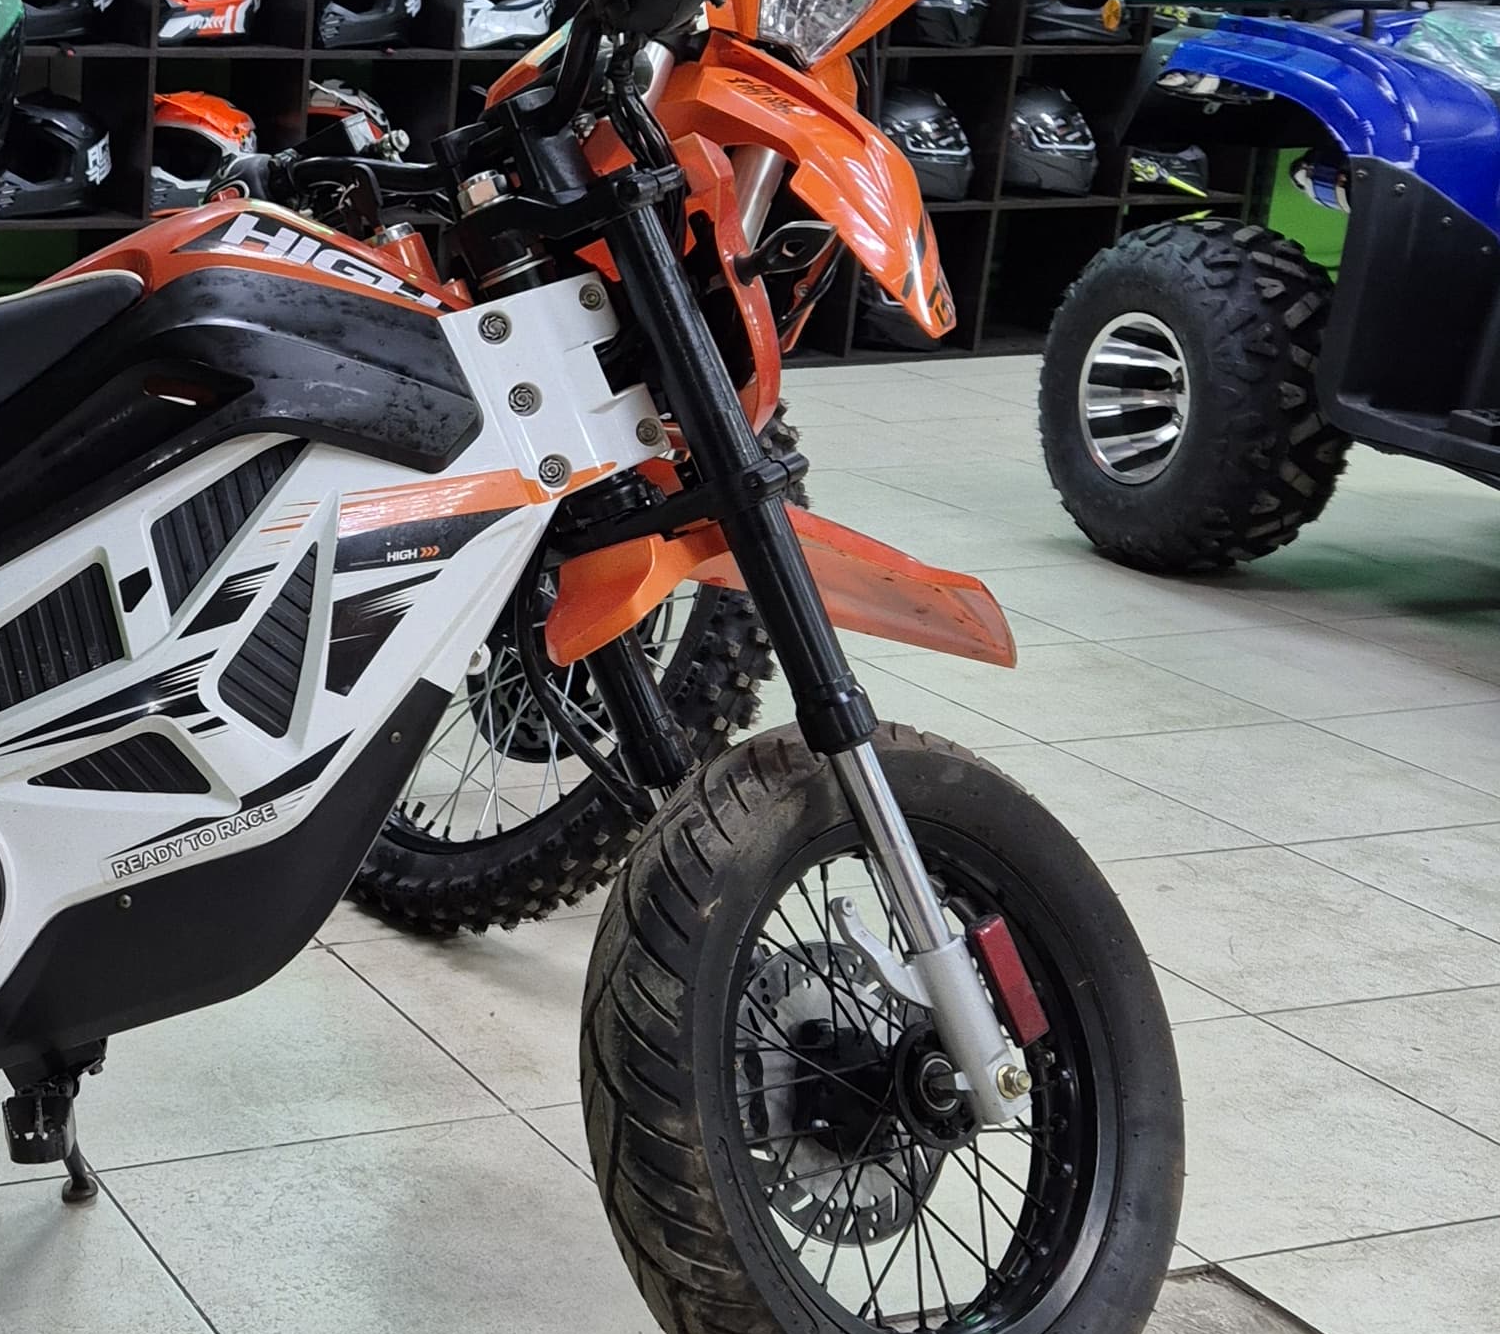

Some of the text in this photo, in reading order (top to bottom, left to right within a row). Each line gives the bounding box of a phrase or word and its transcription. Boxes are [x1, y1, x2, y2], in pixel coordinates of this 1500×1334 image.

[386, 548, 418, 563] HIGH
[111, 803, 278, 879] READY TO RACE
